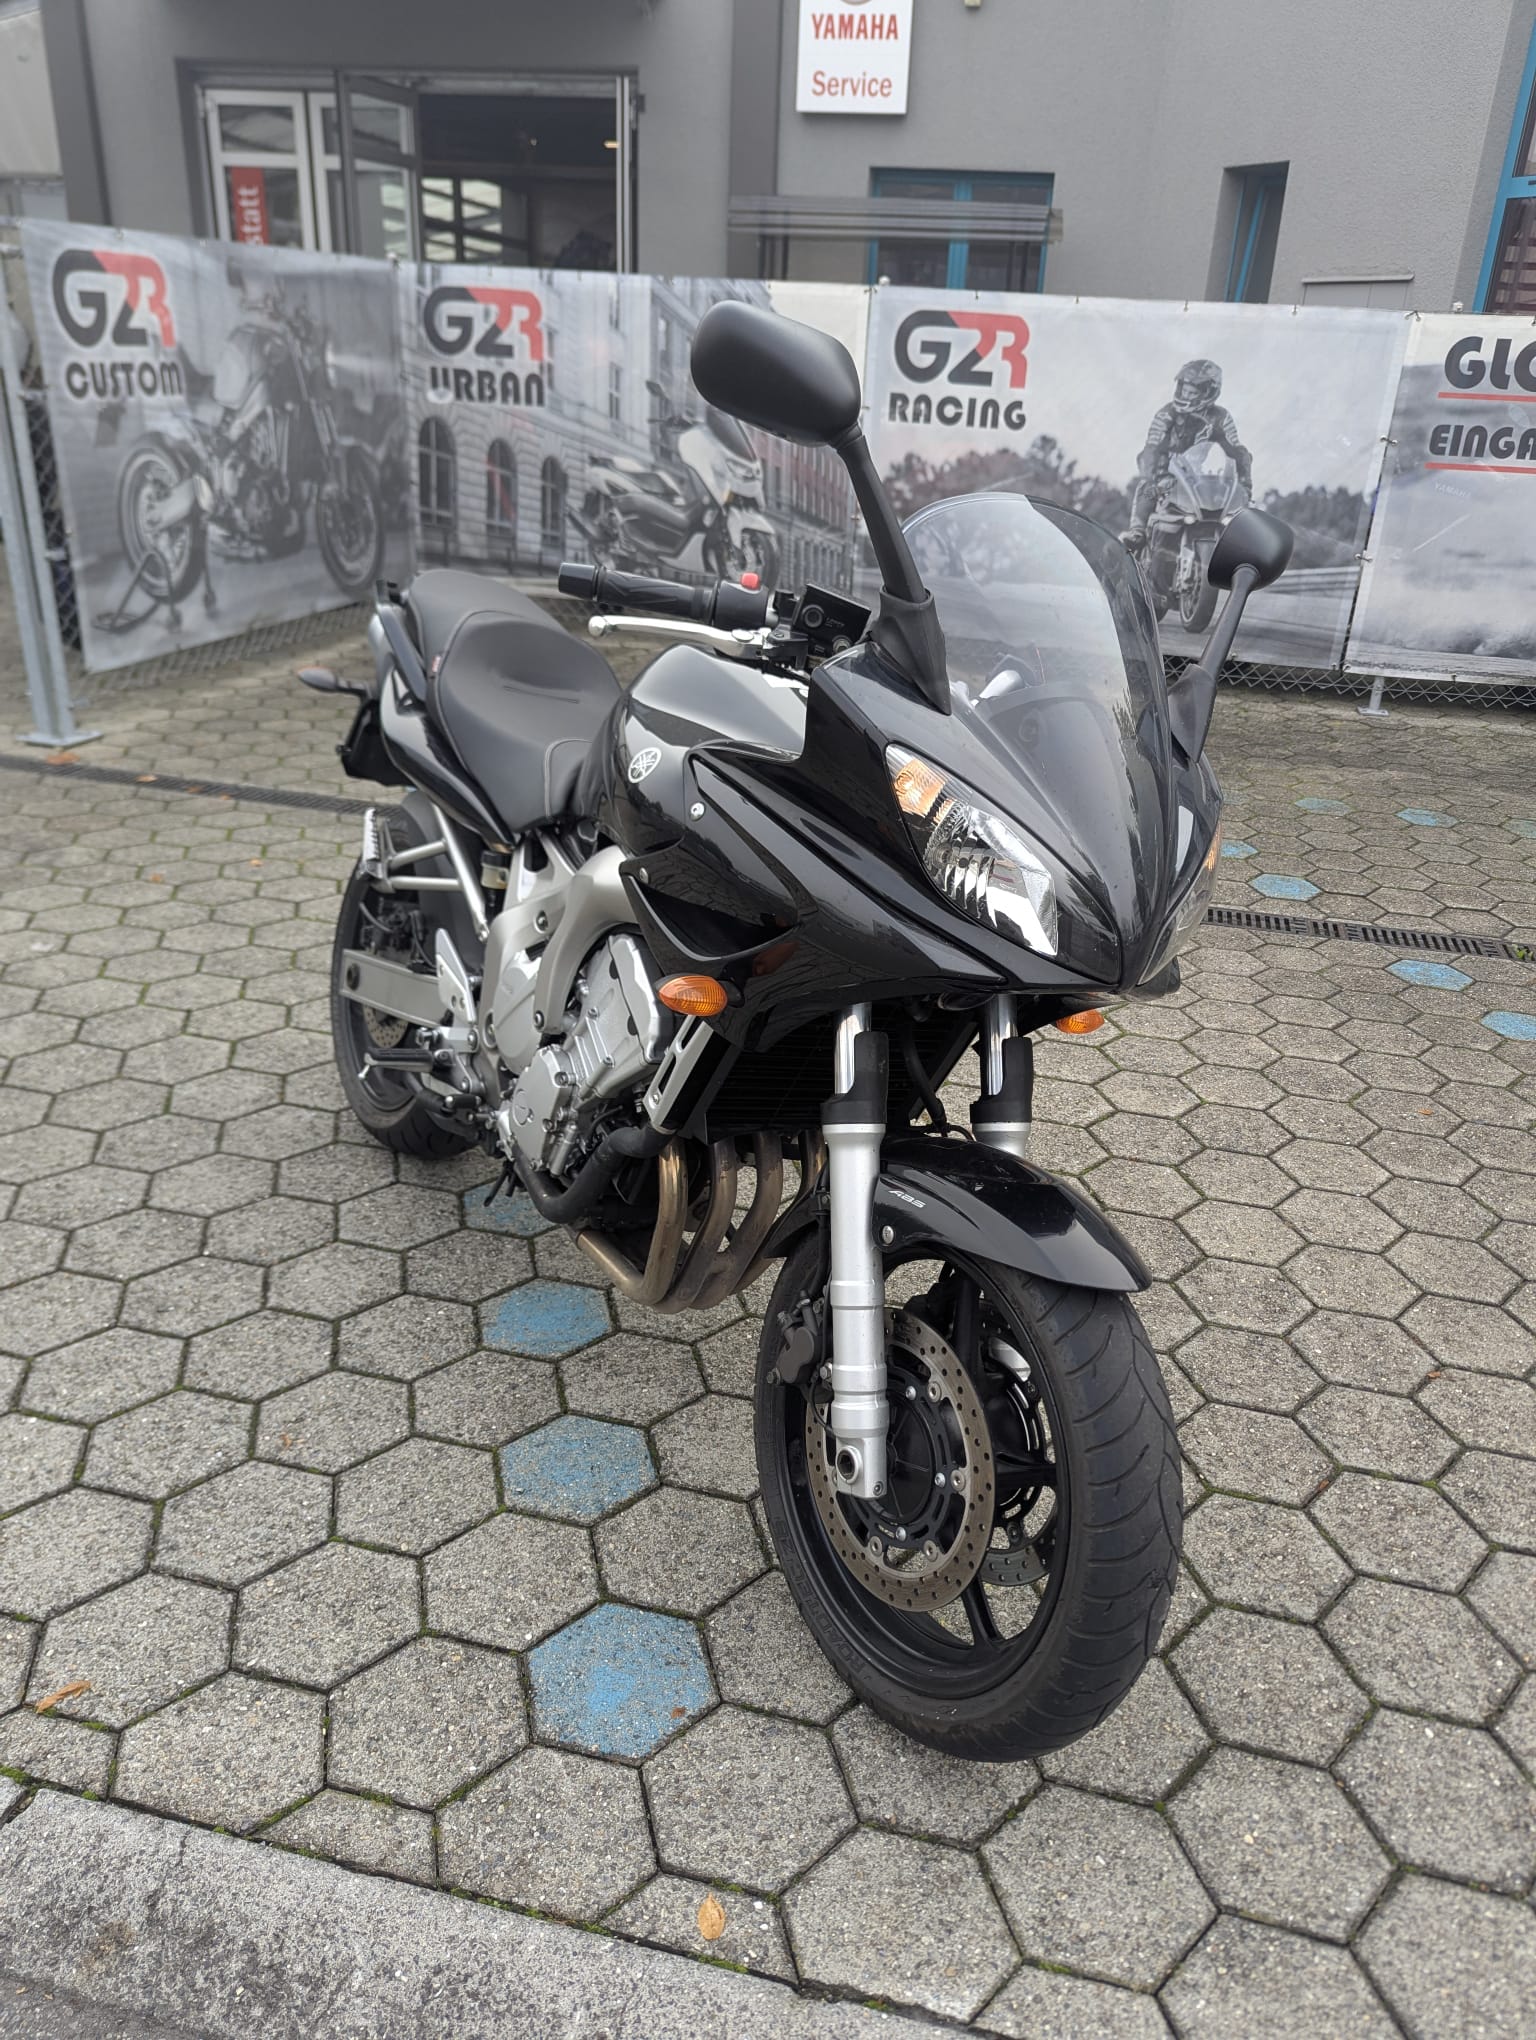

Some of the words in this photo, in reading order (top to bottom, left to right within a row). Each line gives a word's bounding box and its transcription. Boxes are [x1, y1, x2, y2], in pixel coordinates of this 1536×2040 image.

[812, 13, 898, 40] YAMAHA
[812, 70, 893, 98] Service
[65, 361, 183, 398] CUSTOM
[430, 366, 545, 407] URBAN
[888, 392, 1026, 431] RACING
[1428, 424, 1536, 461] EINGA
[887, 1190, 927, 1209] ABS
